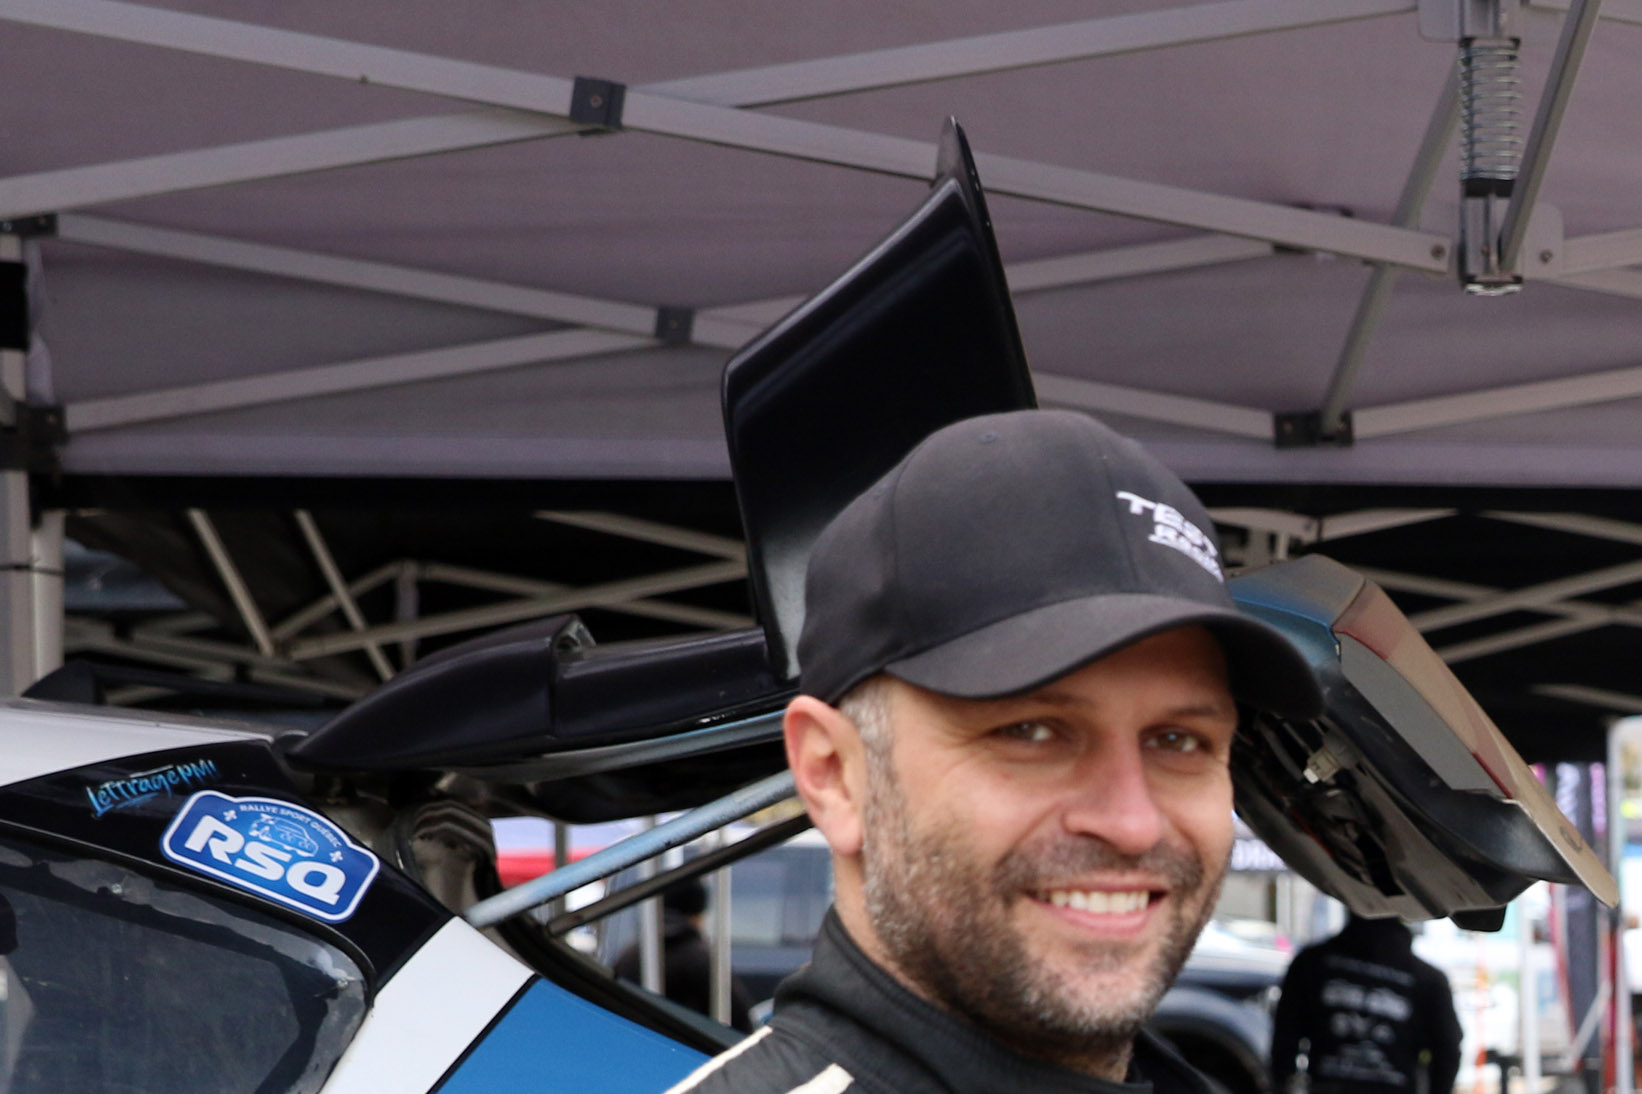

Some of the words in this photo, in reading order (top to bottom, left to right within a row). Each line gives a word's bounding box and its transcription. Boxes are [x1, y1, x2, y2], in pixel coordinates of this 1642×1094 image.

[239, 803, 279, 815] RALLYE
[279, 808, 312, 824] SPORT
[184, 814, 347, 906] RSQ
